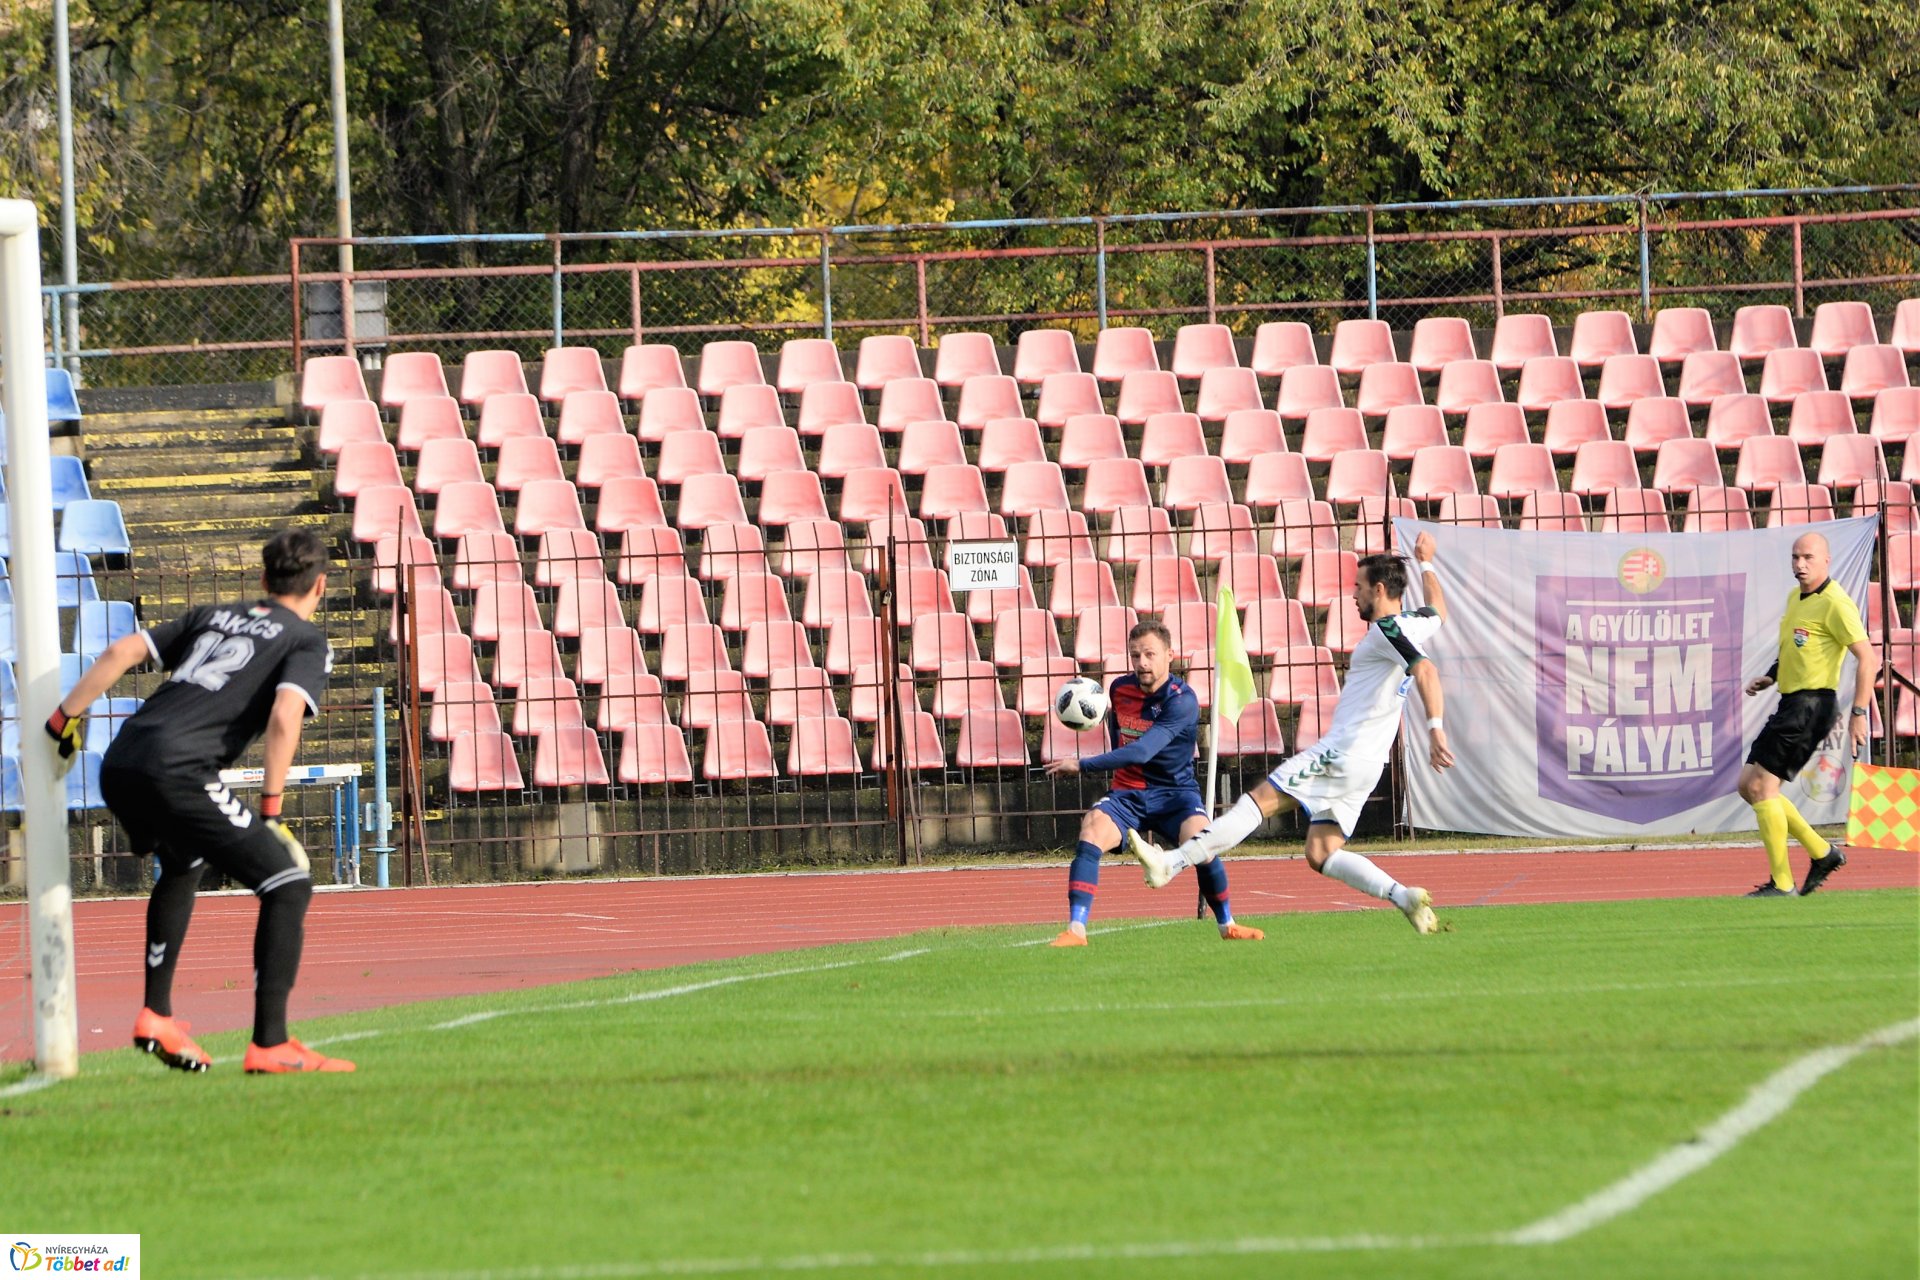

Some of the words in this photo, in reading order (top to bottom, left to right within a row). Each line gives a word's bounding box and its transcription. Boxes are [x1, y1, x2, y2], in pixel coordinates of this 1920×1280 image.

[954, 549, 1013, 565] BIZTONSÁGI
[970, 567, 998, 582] ZÓNA
[1565, 614, 1584, 641] A
[1590, 609, 1714, 642] GYŰLÖLET
[170, 630, 255, 692] 12
[1565, 643, 1713, 716] NEM
[1566, 717, 1714, 773] PÁLYA!
